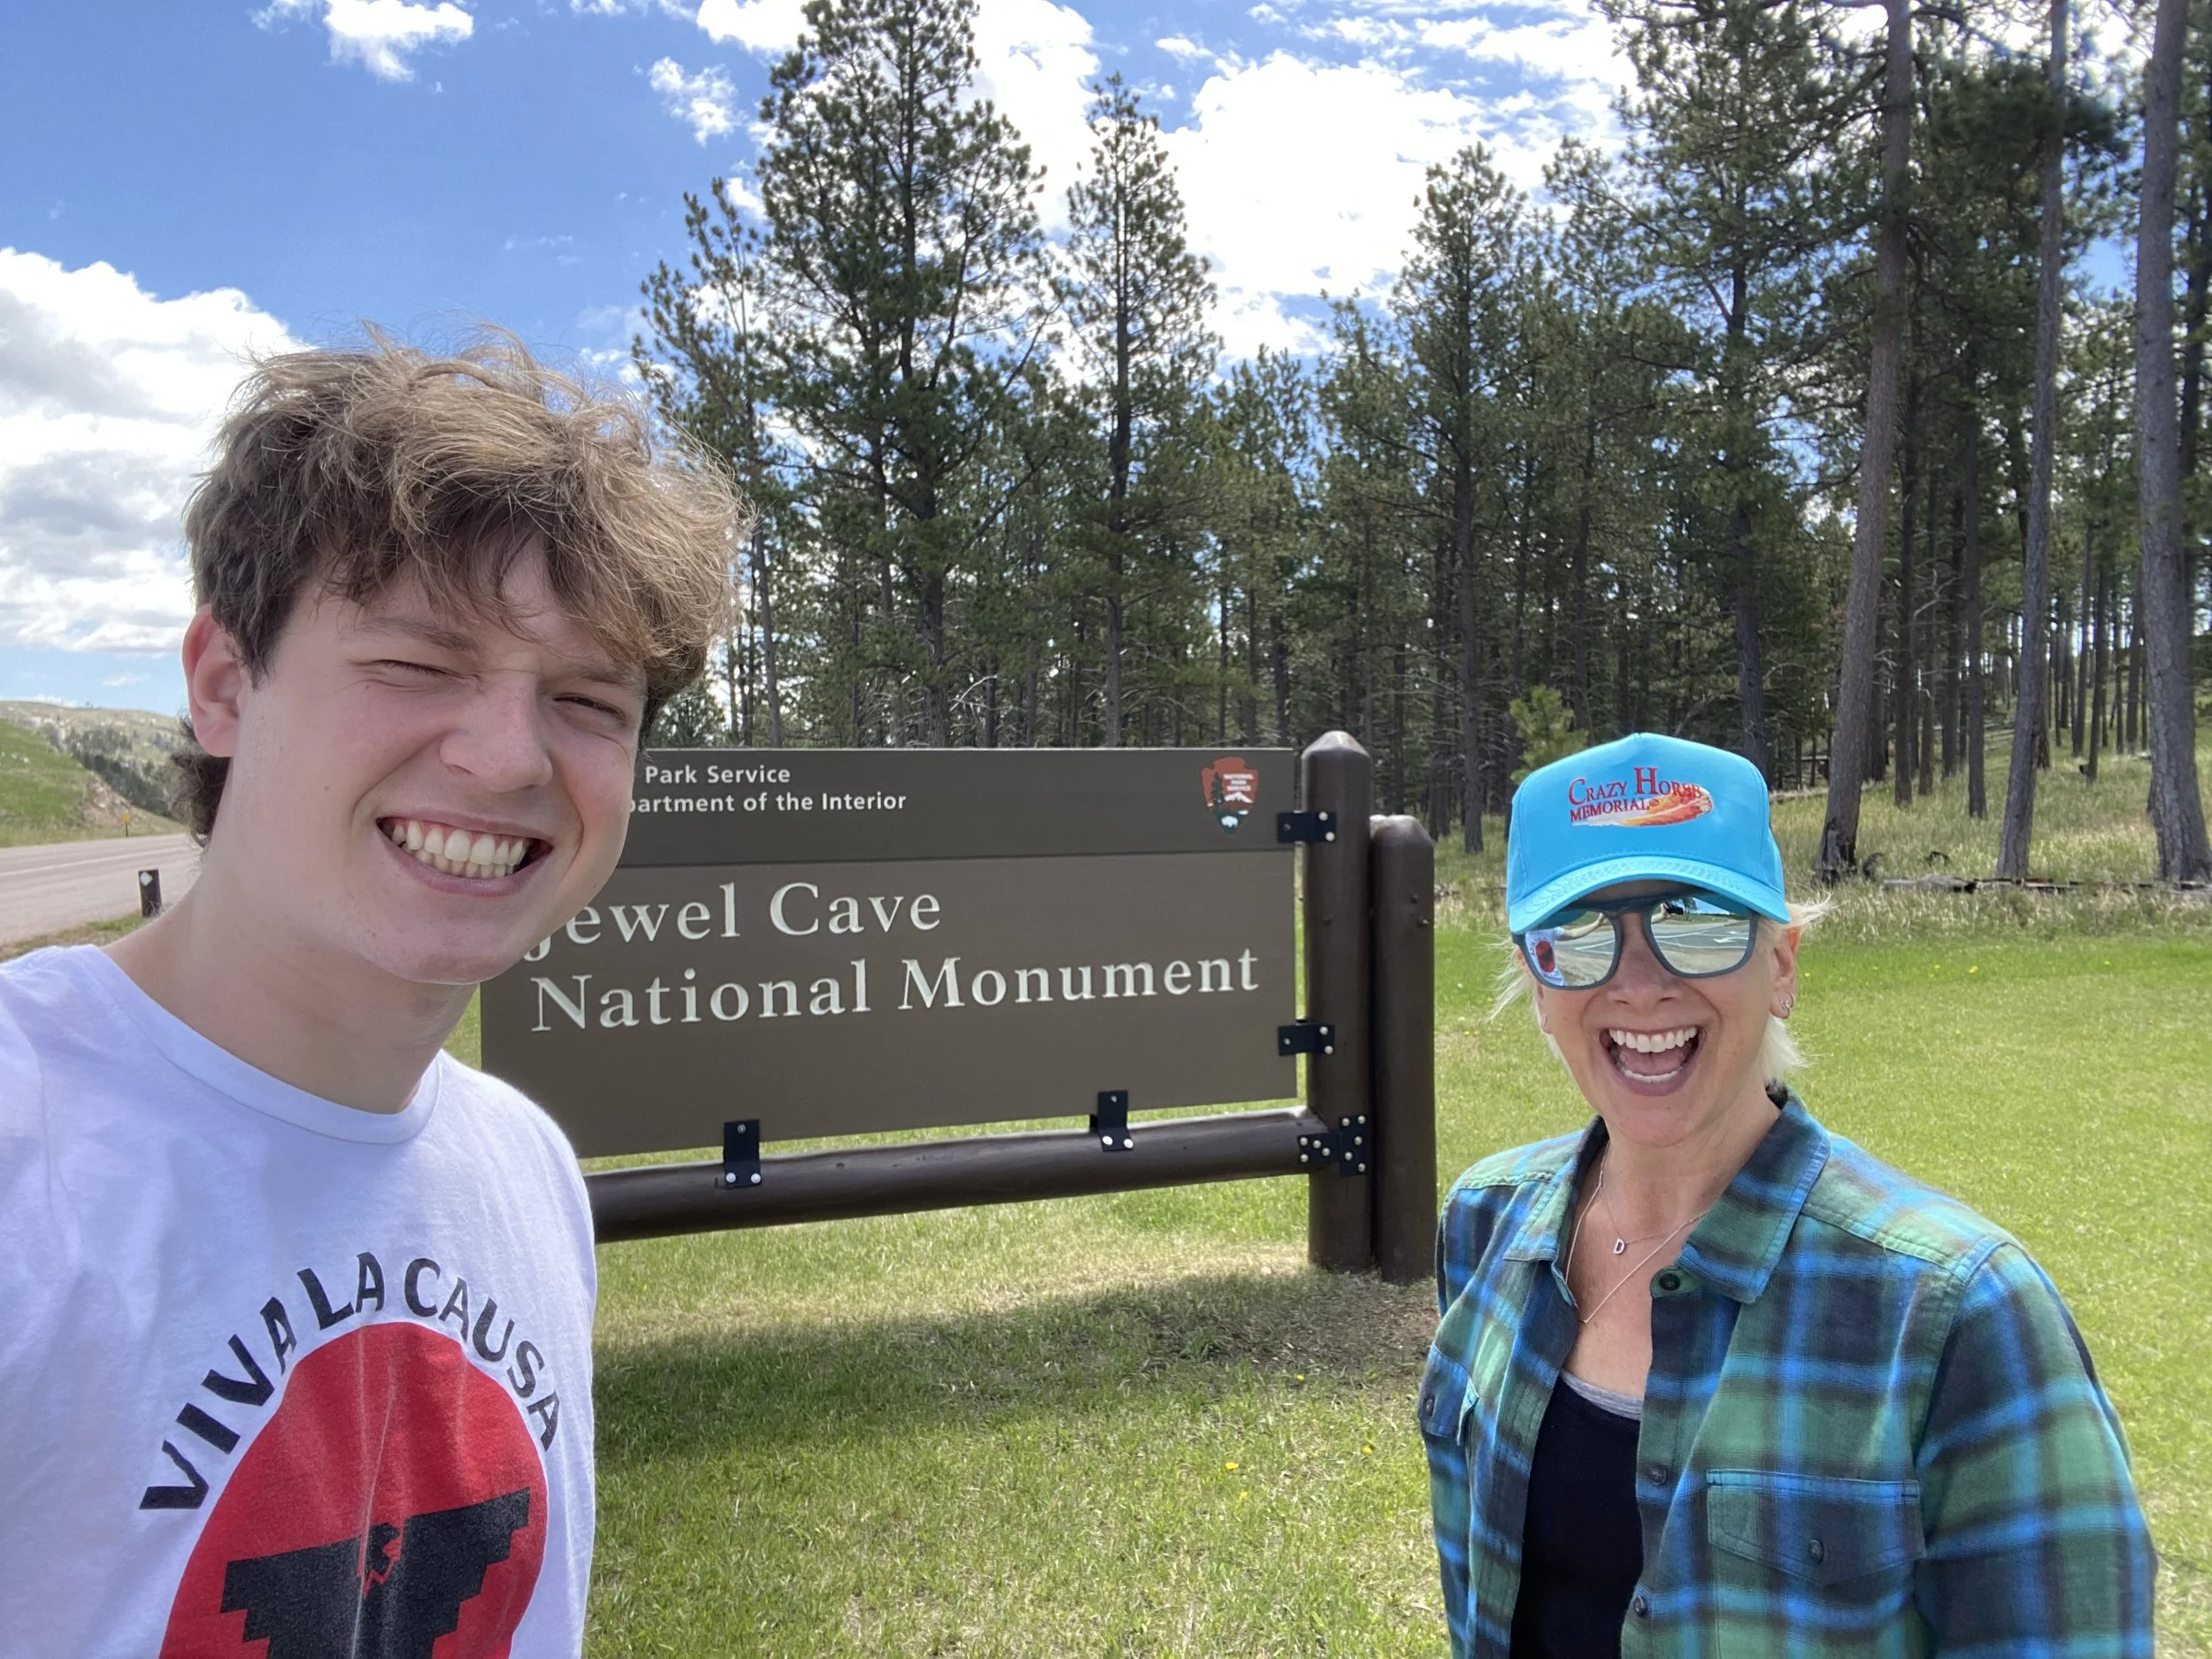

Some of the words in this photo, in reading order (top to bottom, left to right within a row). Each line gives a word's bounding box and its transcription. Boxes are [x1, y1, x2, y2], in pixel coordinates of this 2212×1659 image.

[645, 764, 697, 784] Park
[707, 764, 791, 784] Service
[1568, 777, 1627, 806] CRAZY
[743, 792, 768, 811] of
[775, 791, 813, 811] the
[822, 791, 907, 810] Interior
[770, 882, 941, 936] Cave
[531, 957, 872, 1032] National
[898, 949, 1259, 1010] Monument
[139, 1296, 296, 1509] VIVA
[297, 1252, 385, 1330] LA
[404, 1258, 561, 1451] CAUSA
